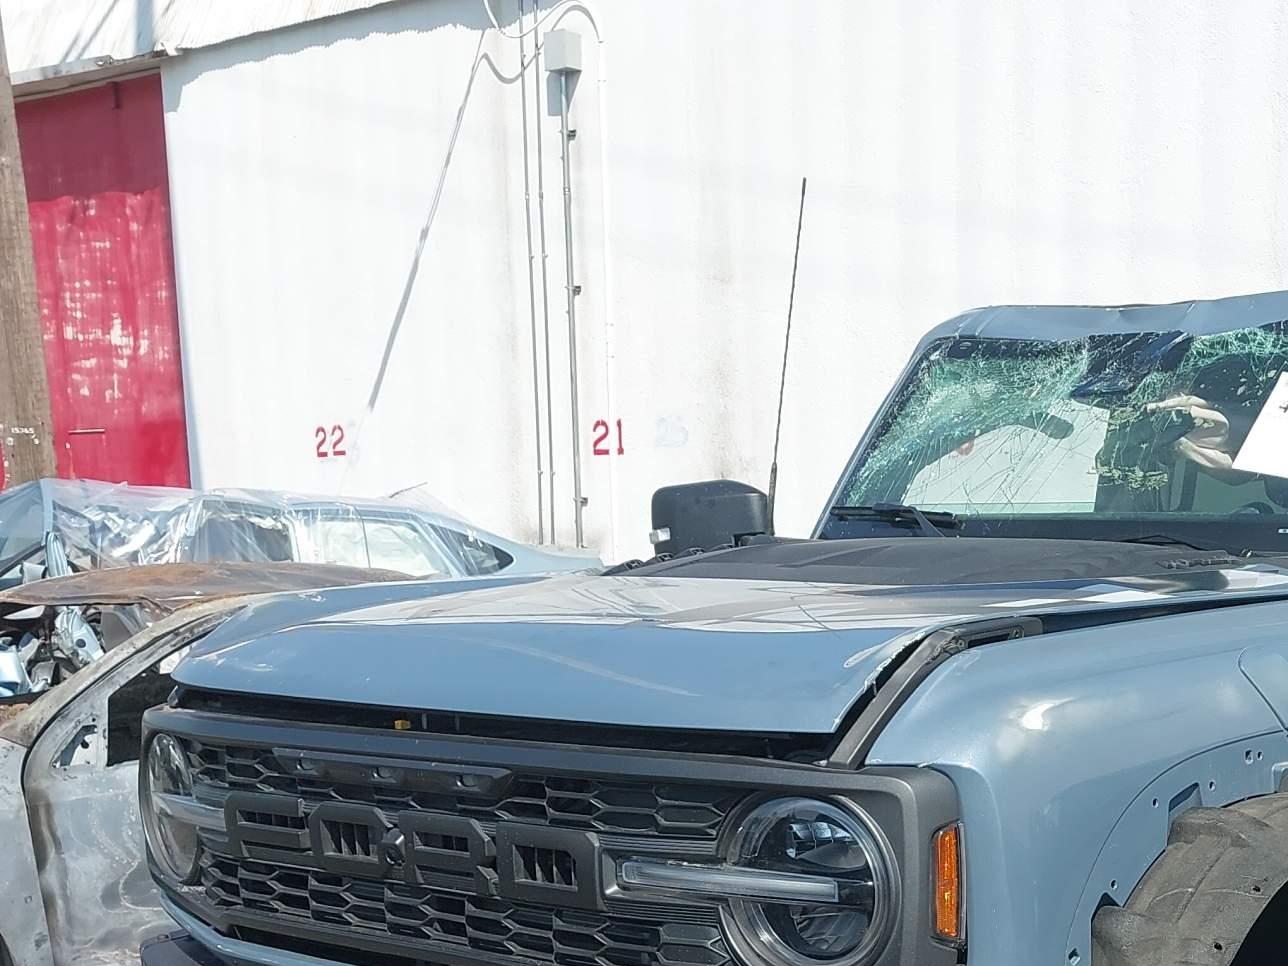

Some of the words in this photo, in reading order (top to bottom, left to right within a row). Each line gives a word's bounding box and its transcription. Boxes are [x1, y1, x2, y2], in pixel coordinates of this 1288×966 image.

[315, 424, 346, 457] 22
[592, 418, 624, 456] 21
[224, 790, 608, 911] FORD
